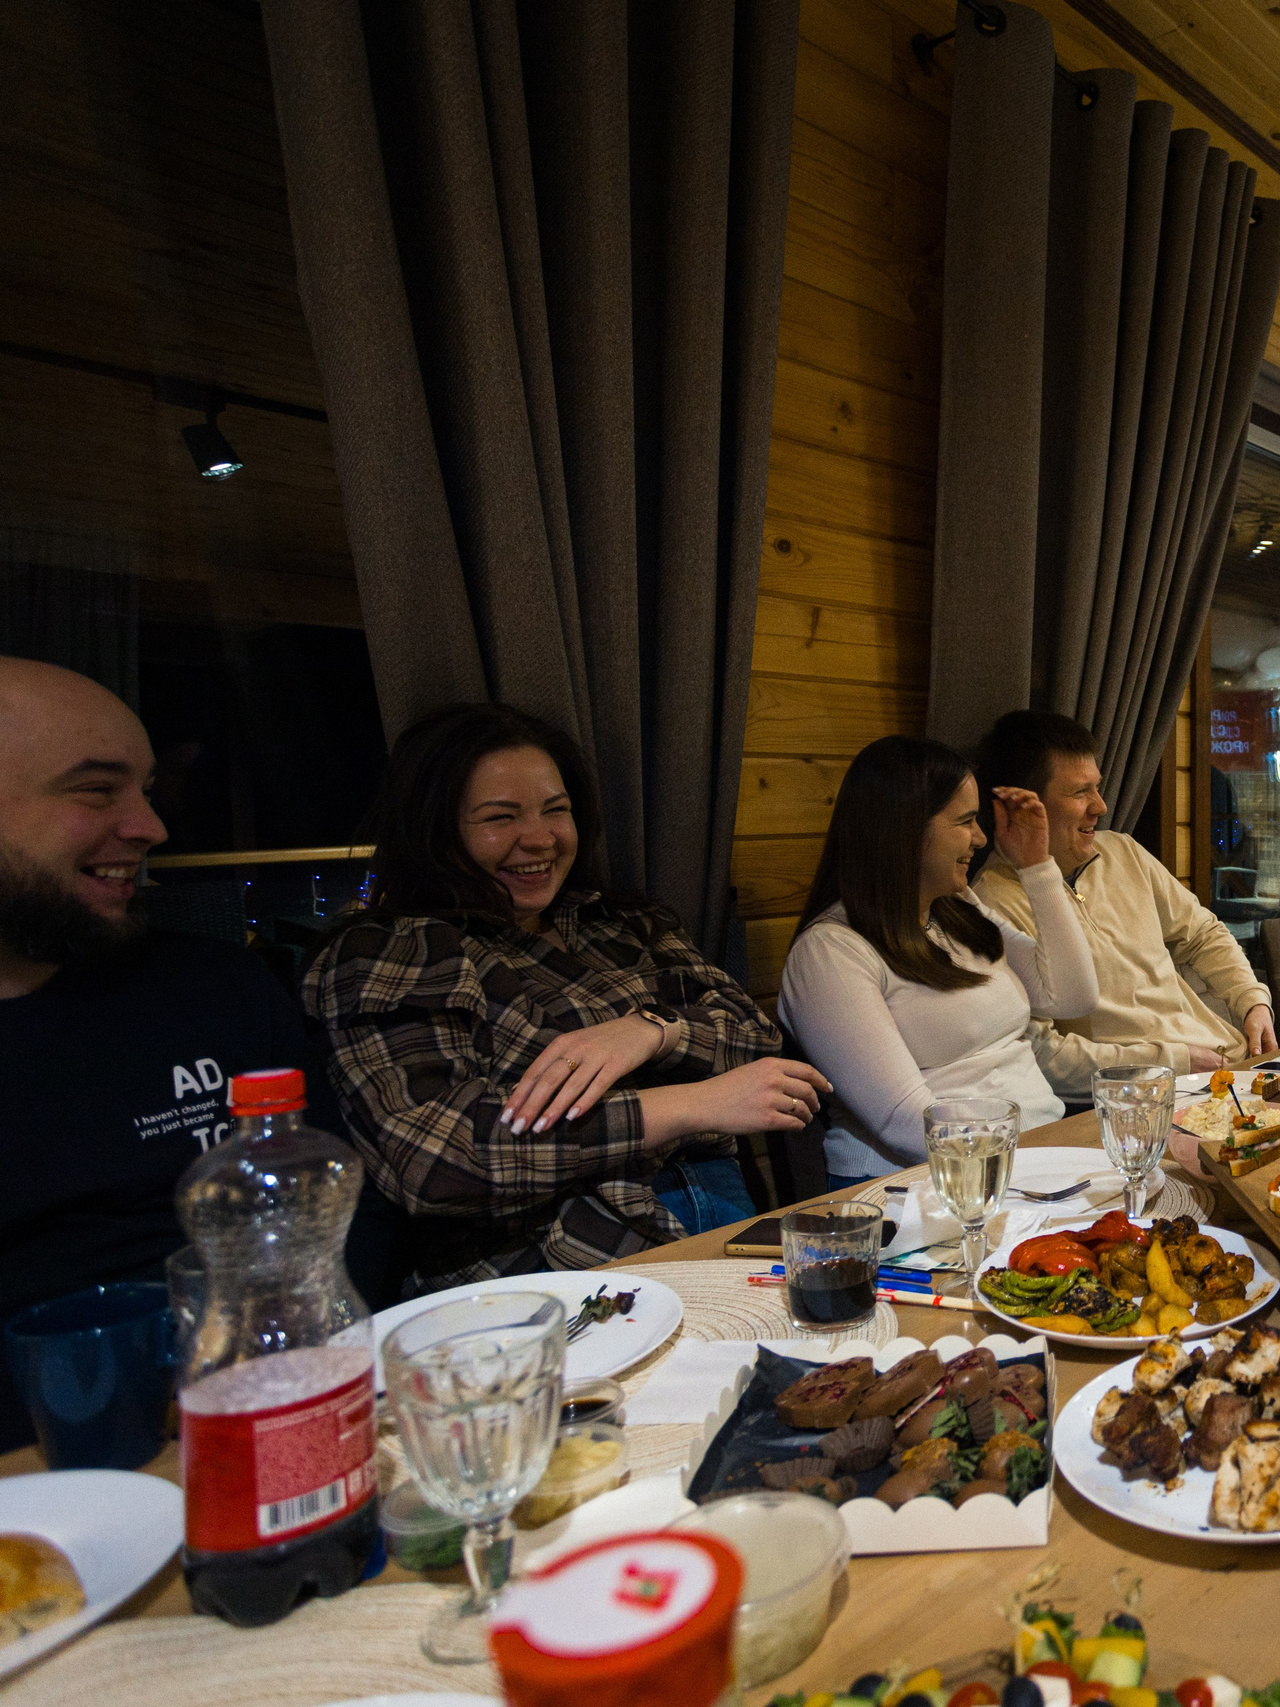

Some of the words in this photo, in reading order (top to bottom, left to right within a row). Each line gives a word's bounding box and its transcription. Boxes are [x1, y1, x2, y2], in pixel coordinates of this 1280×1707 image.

[133, 1118, 140, 1127] I
[141, 1108, 180, 1125] haven't
[181, 1099, 219, 1114] changed,
[140, 1127, 160, 1140] you
[161, 1121, 182, 1134] just
[183, 1112, 215, 1127] became
